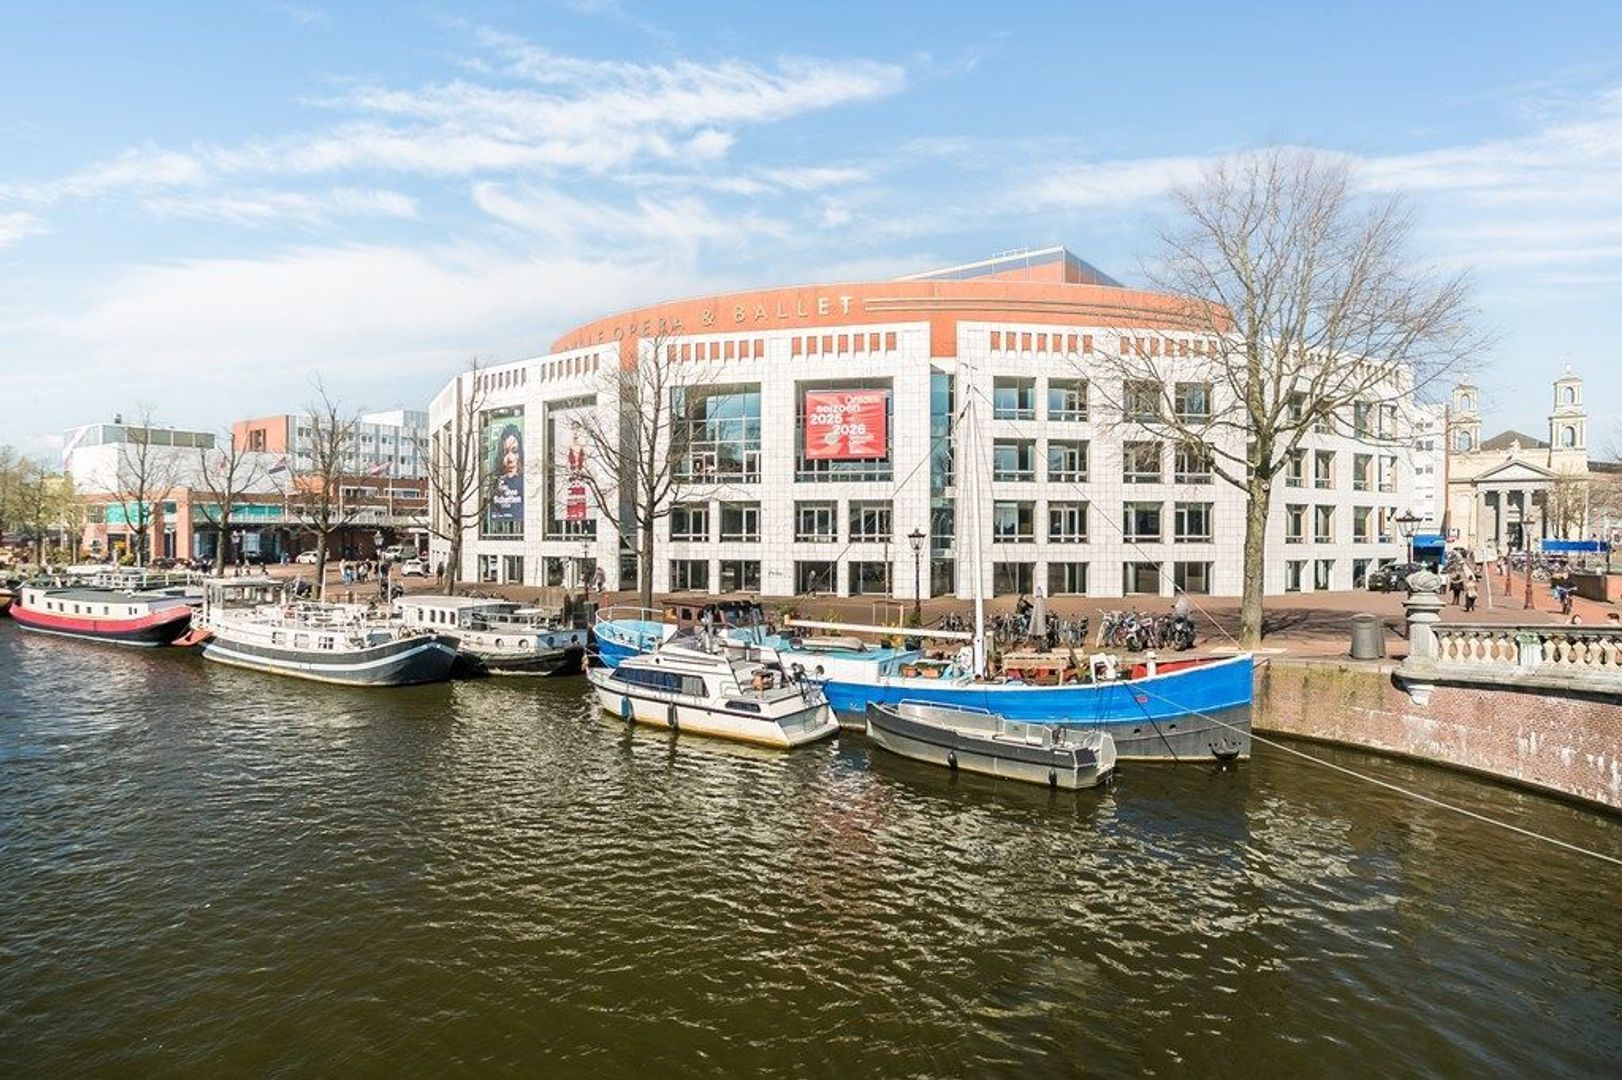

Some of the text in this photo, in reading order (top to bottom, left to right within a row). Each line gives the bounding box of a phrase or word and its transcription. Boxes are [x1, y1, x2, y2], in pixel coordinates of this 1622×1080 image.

[613, 317, 686, 341] OPERA
[702, 309, 716, 326] &
[735, 295, 854, 324] BALLET
